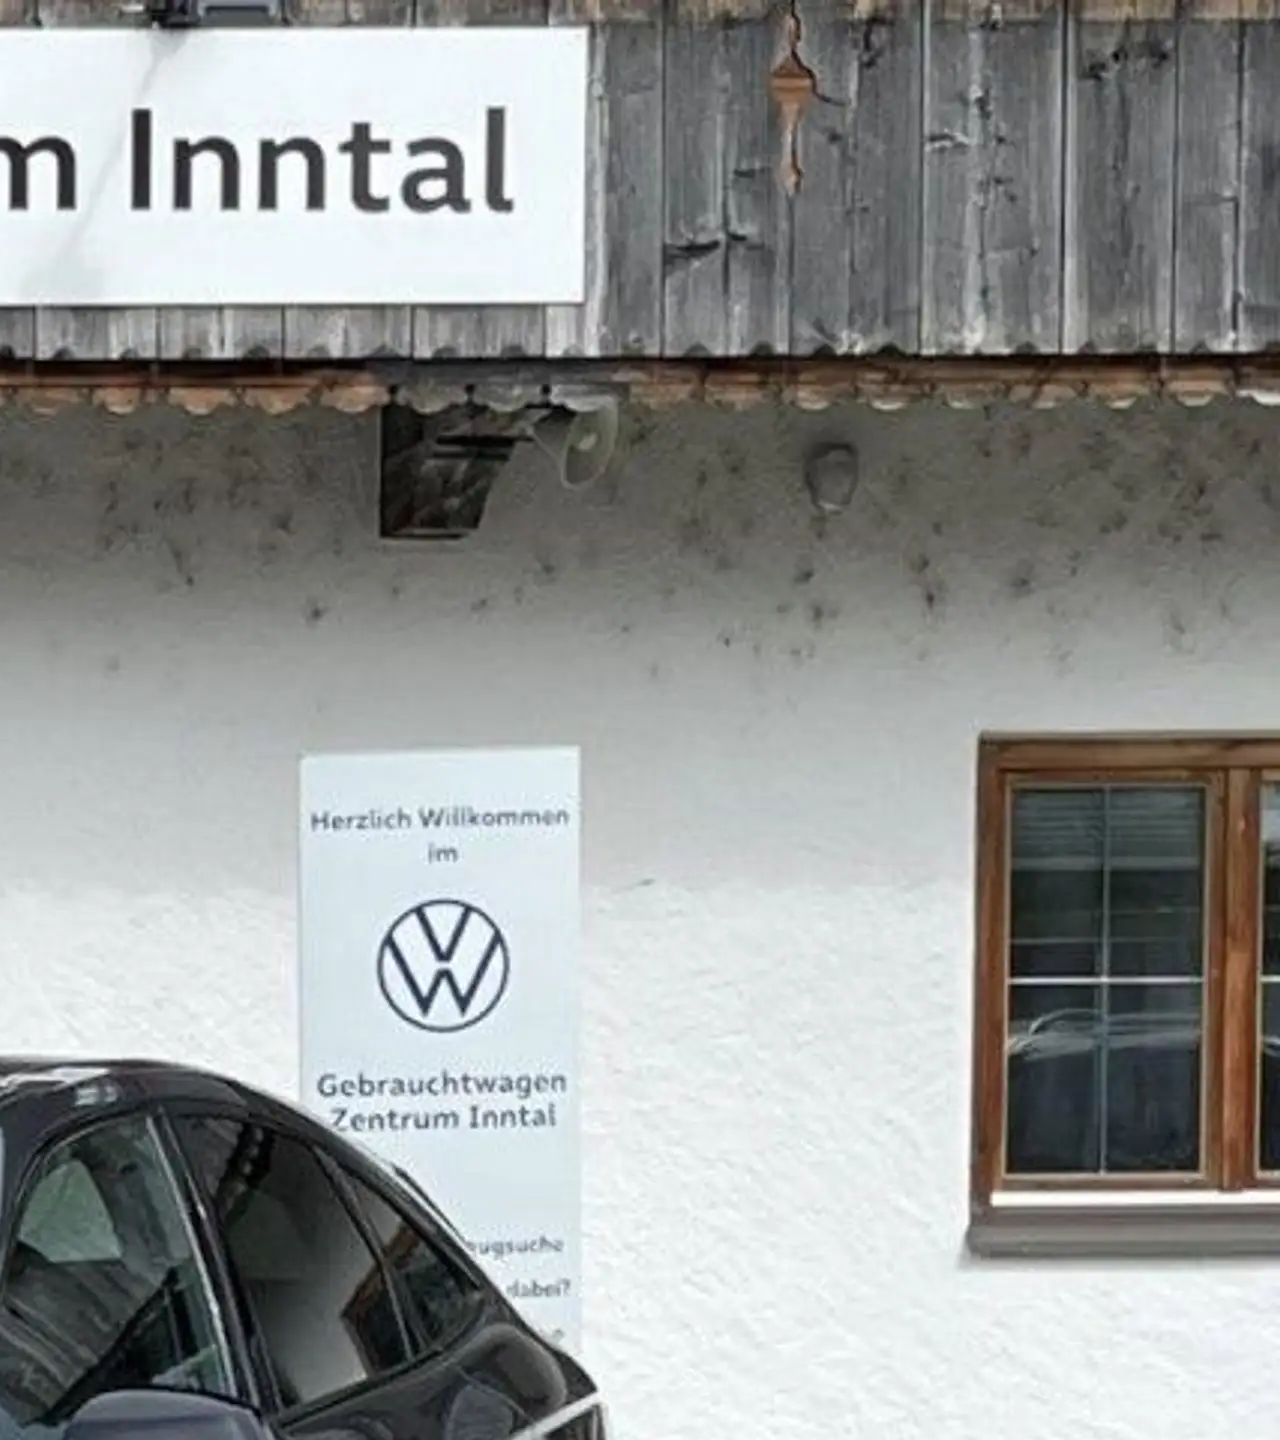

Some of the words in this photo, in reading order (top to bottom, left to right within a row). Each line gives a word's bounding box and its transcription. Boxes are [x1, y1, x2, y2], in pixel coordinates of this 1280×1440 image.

[129, 105, 514, 213] Inntal
[311, 809, 411, 831] Herzlich
[417, 805, 570, 830] Willkommen
[427, 843, 459, 863] im
[378, 899, 509, 1032] VW
[317, 1068, 567, 1100] Gebrauchtwagen
[330, 1106, 460, 1132] Zentrum
[468, 1102, 557, 1129] Inntal
